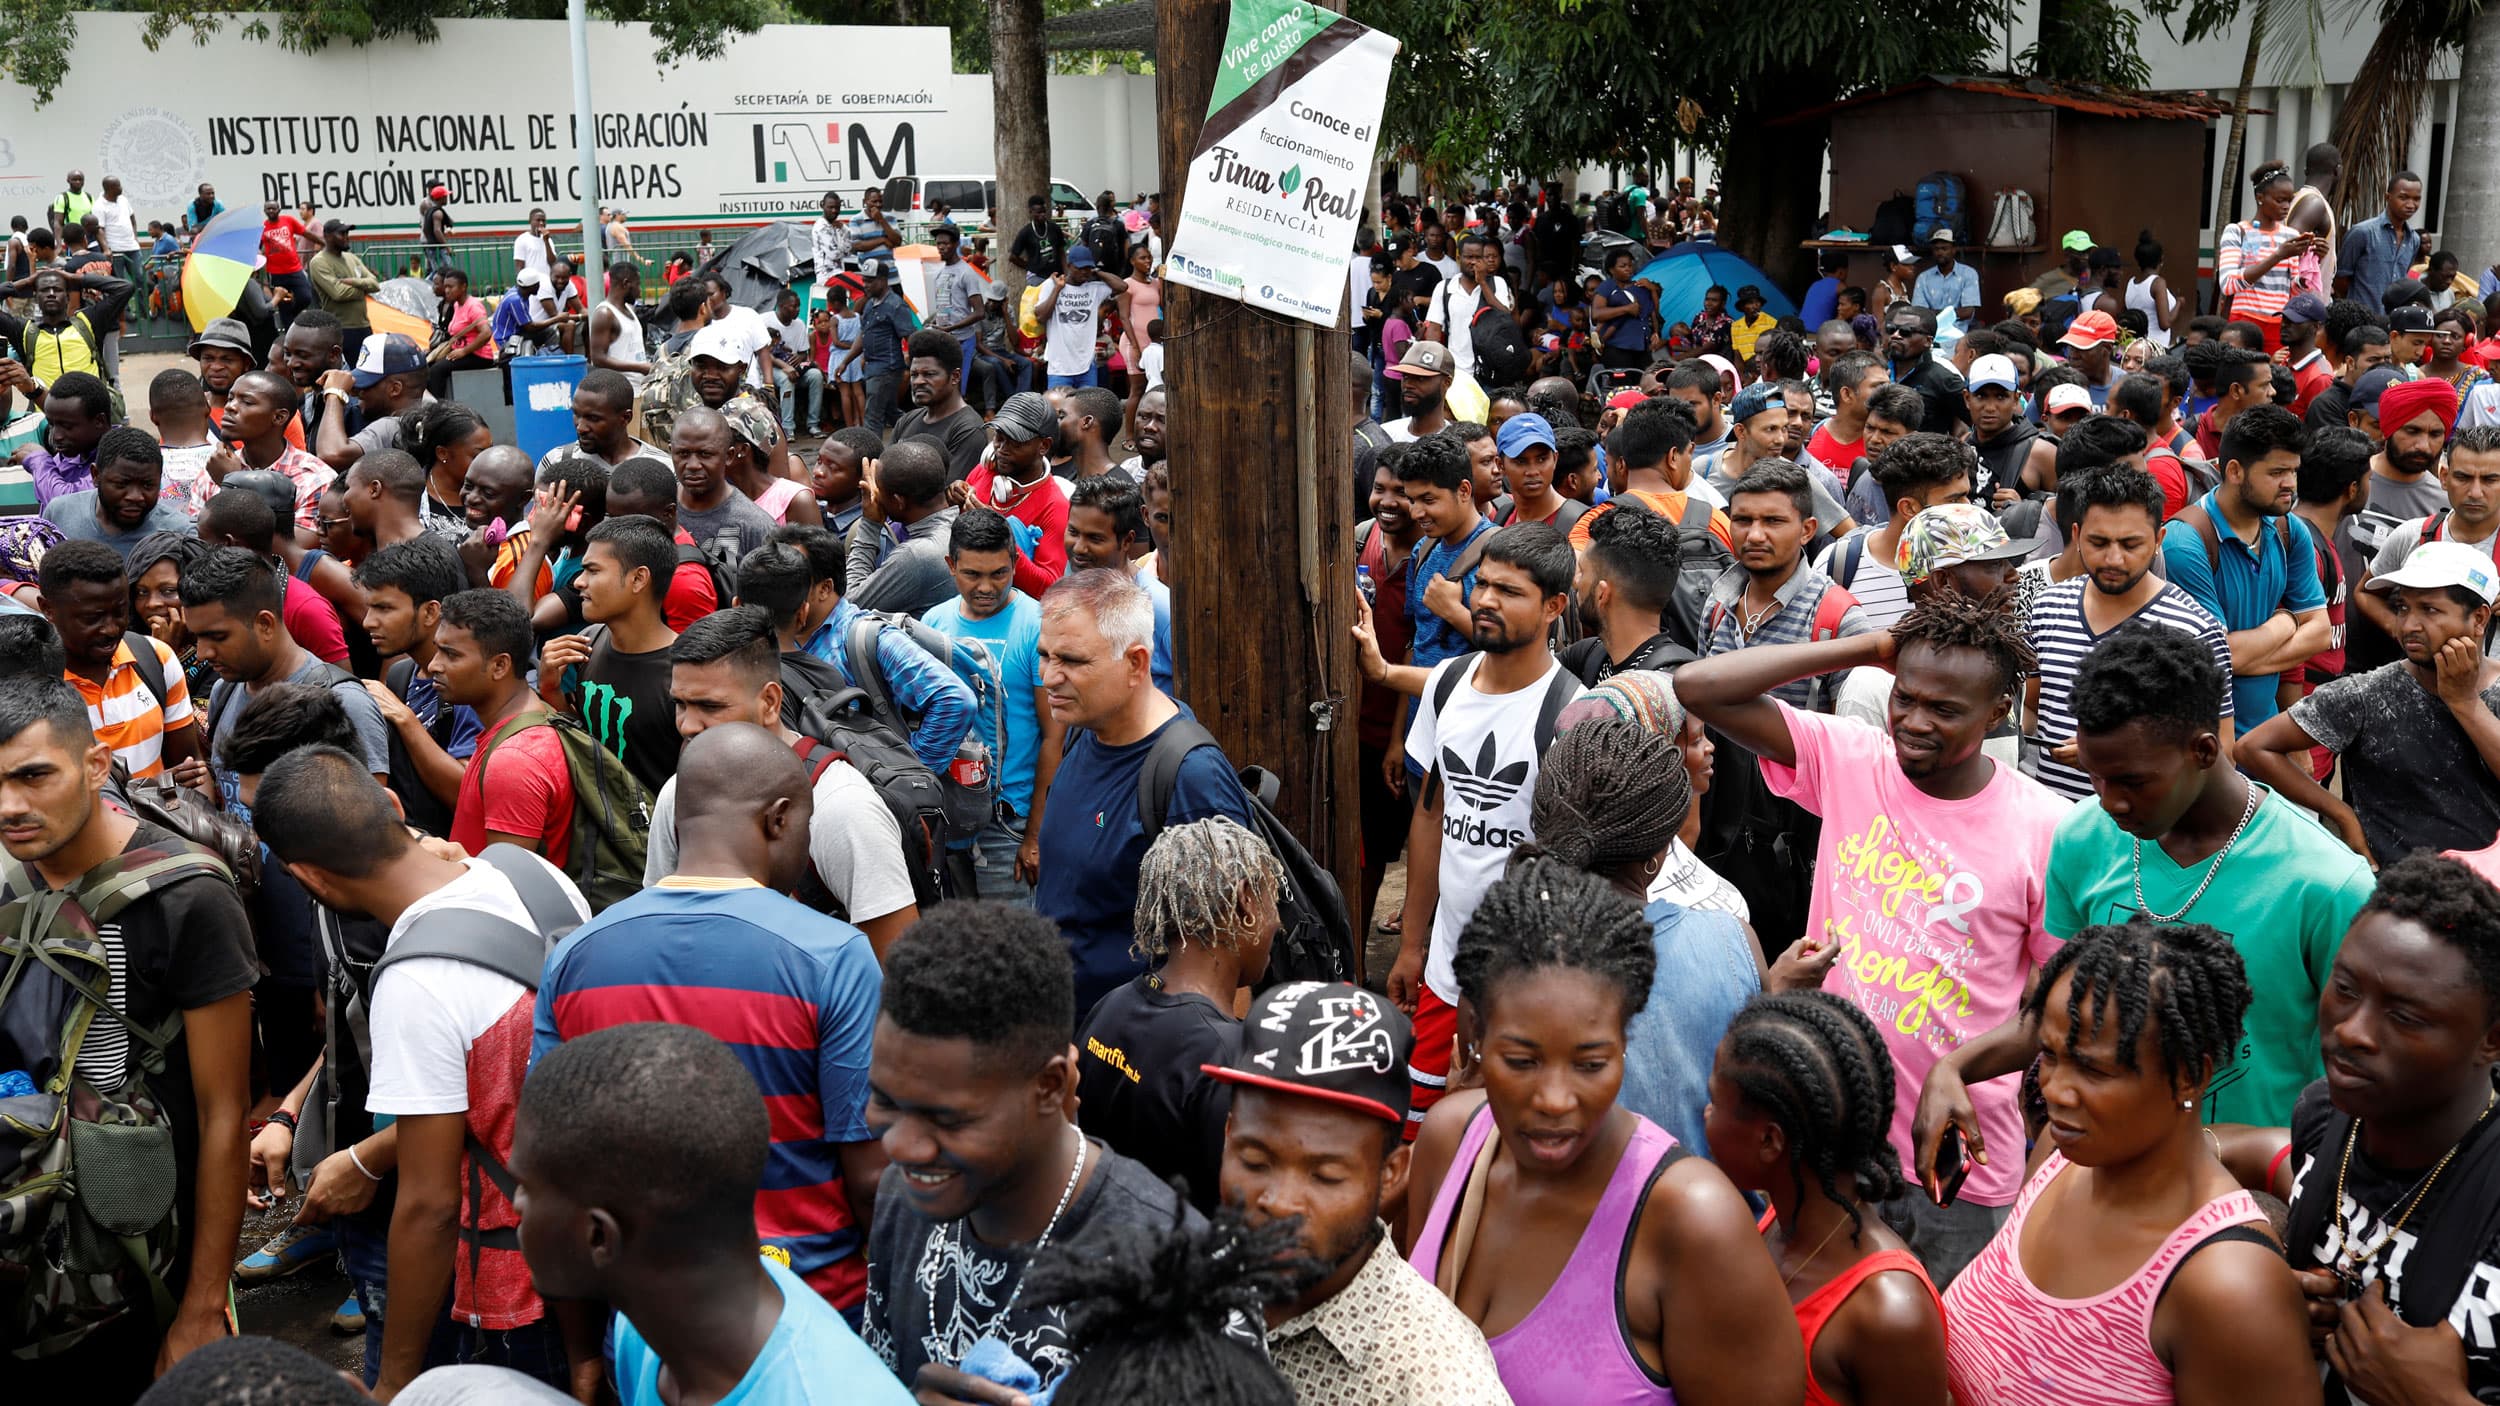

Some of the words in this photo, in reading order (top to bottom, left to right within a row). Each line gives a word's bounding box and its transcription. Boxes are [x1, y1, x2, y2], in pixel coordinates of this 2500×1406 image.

[1224, 37, 1259, 70] Vive
[1261, 6, 1303, 43] como
[1243, 63, 1259, 82] te
[1261, 29, 1302, 71] gusta
[734, 90, 808, 105] SECRETARÍA
[816, 94, 833, 105] DE
[842, 89, 933, 105] GOBERNACIÓN
[208, 115, 360, 156] INSTITUTO
[376, 114, 514, 153] NACIONAL
[528, 114, 557, 150] DE
[1290, 100, 1350, 135] Conoce
[1354, 125, 1371, 142] el
[1260, 127, 1354, 171] fraccionamiento
[262, 160, 416, 210] DELEGACIÓN
[528, 166, 560, 202] EN
[567, 163, 683, 201] CIAPAS
[1209, 146, 1275, 194] Finca
[1302, 177, 1358, 220] Real
[719, 200, 785, 213] INSTITUTO
[790, 199, 854, 211] NACIAL
[1226, 196, 1326, 238] RESIDENCIAL
[1184, 211, 1210, 226] Frente
[1285, 243, 1309, 257] norte
[1187, 260, 1213, 280] Casa
[1215, 268, 1243, 288] Nueva
[1276, 293, 1299, 306] Casa
[1301, 300, 1332, 315] Nueva
[1444, 814, 1525, 848] adidas
[1838, 815, 1946, 917] hope
[1863, 911, 1905, 948] ONLY
[1905, 901, 1921, 920] IS
[1825, 915, 1974, 1035] ronger
[1862, 988, 1898, 1022] FEAR
[1087, 1036, 1141, 1084] smartfit.om.br
